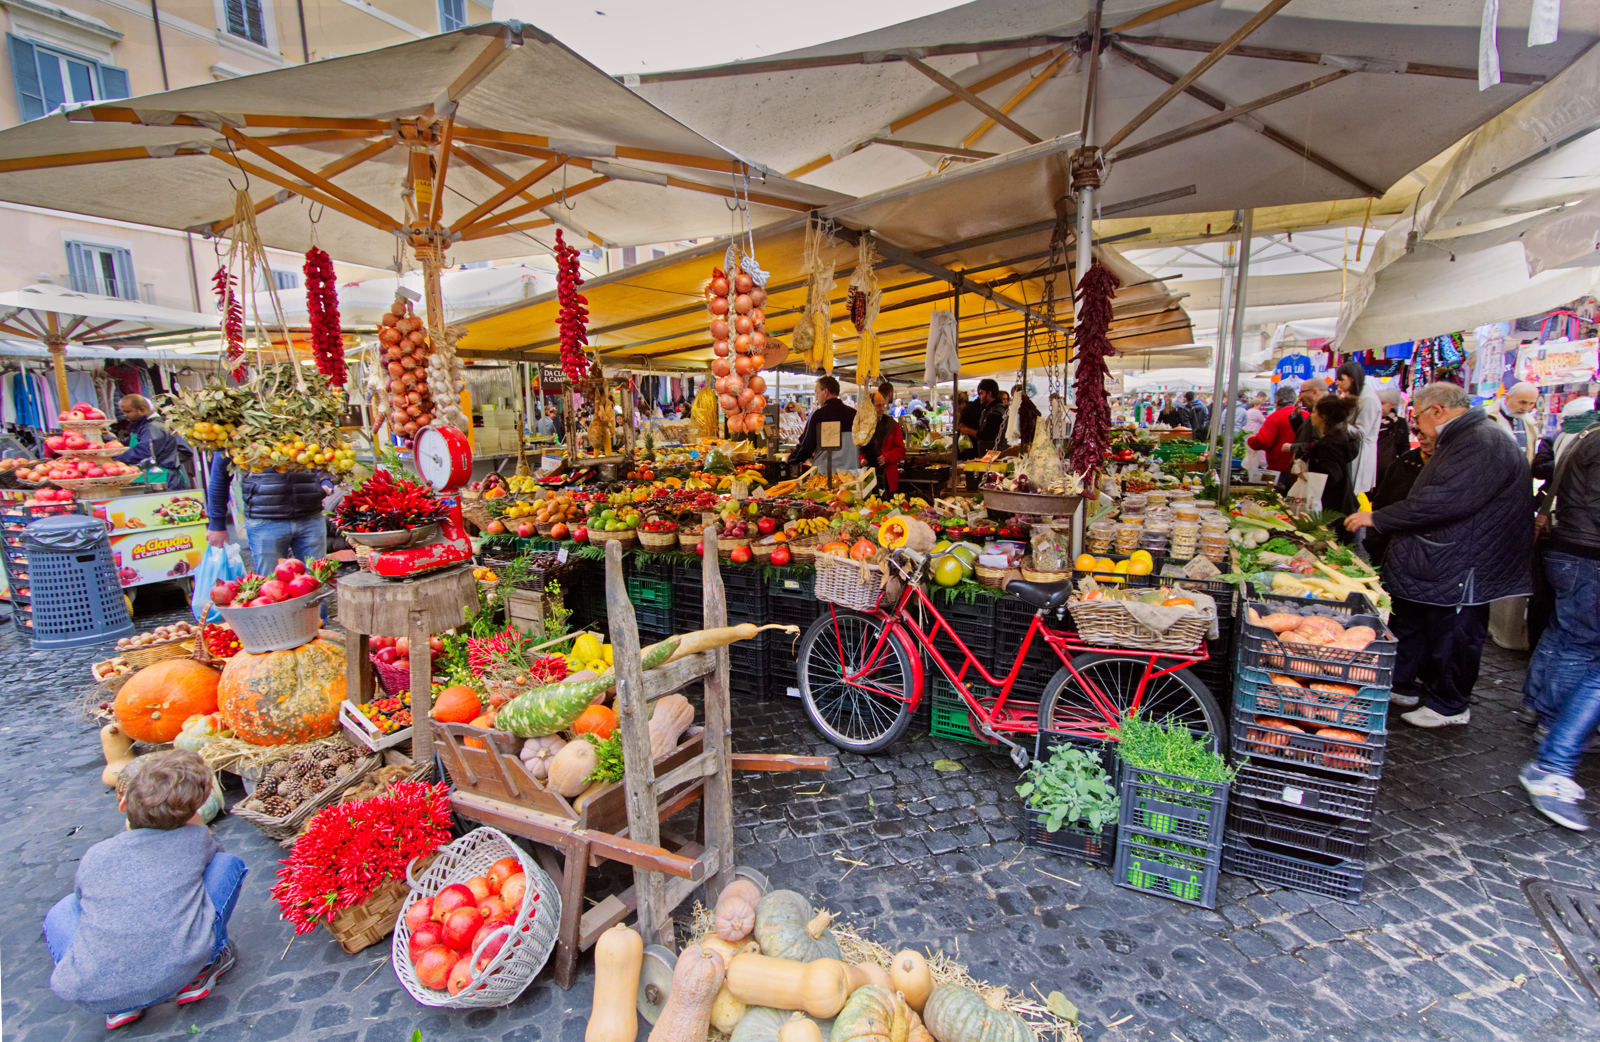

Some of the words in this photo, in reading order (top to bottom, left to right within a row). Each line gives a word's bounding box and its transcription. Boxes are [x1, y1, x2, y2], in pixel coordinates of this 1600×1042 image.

[133, 544, 146, 554] da
[146, 535, 190, 551] Claudio
[141, 549, 165, 558] Campo
